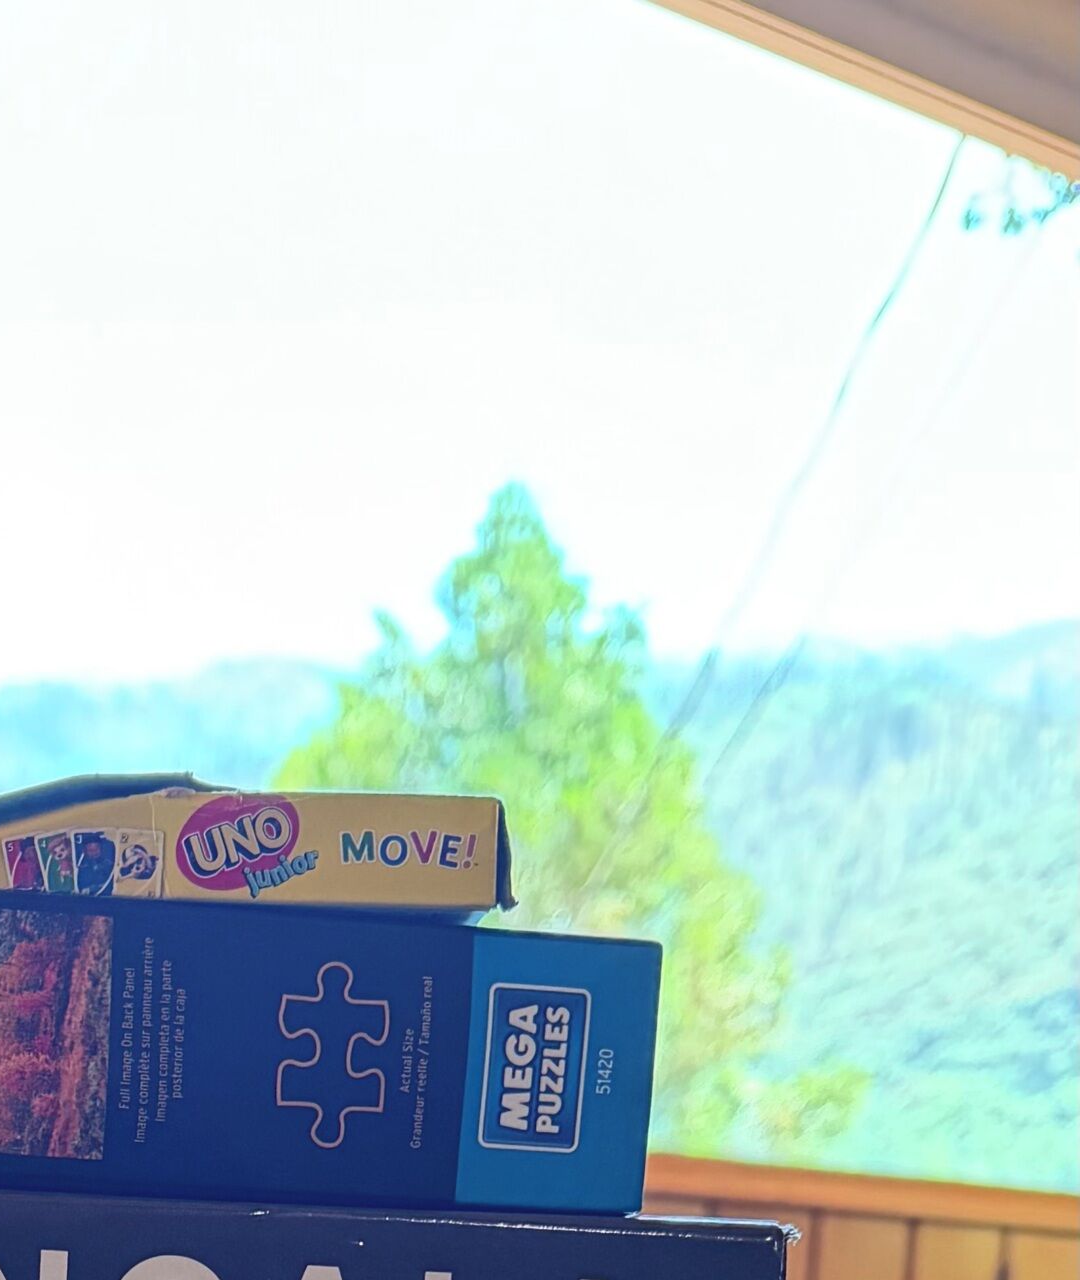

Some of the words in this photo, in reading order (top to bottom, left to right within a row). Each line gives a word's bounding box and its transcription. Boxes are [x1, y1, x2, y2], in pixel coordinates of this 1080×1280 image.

[182, 805, 292, 878] UNO
[339, 829, 477, 870] MOVE!
[241, 850, 319, 898] junior
[161, 959, 173, 991] parte
[422, 976, 433, 998] real
[122, 1003, 135, 1028] Back
[141, 979, 153, 1027] panneau
[161, 993, 171, 1005] la
[161, 1006, 170, 1021] en
[176, 988, 187, 1013] caja
[121, 1030, 133, 1047] On
[141, 1028, 151, 1049] sur
[172, 1026, 185, 1043] de
[173, 1015, 185, 1026] la
[418, 1001, 432, 1044] Tamaño
[157, 1024, 170, 1077] completa
[402, 1028, 415, 1051] Size
[120, 1050, 136, 1083] Image
[172, 1045, 184, 1099] posterior
[399, 1053, 412, 1094] Actual
[499, 1004, 539, 1131] MEGA
[535, 1006, 571, 1134] PUZZLES
[595, 1048, 614, 1095] 51420
[119, 1085, 130, 1110] Full
[155, 1080, 169, 1122] Imagen
[134, 1107, 149, 1144] Image
[410, 1093, 425, 1149] Grandeur
